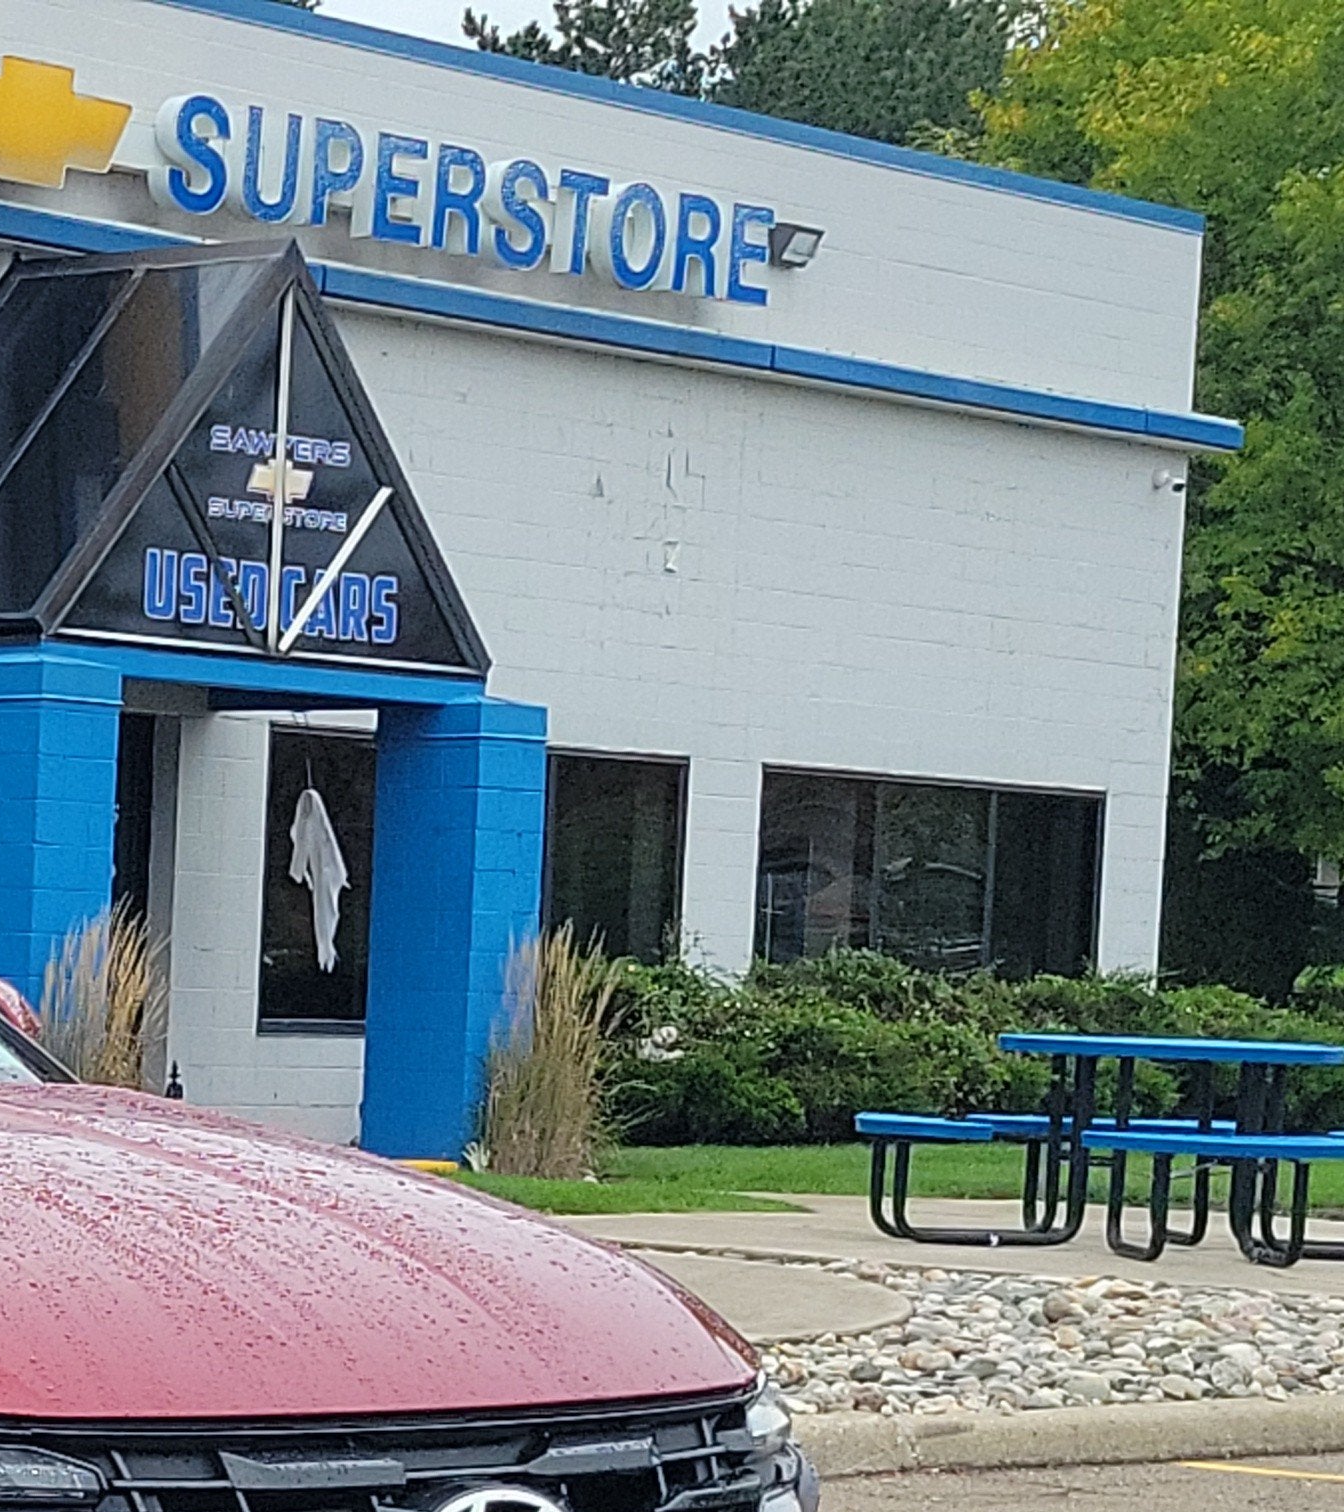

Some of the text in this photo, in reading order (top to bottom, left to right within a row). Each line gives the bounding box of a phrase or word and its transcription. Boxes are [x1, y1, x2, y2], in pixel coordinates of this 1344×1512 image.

[158, 95, 775, 305] SUPERSTORE
[143, 547, 400, 644] USED CARS
